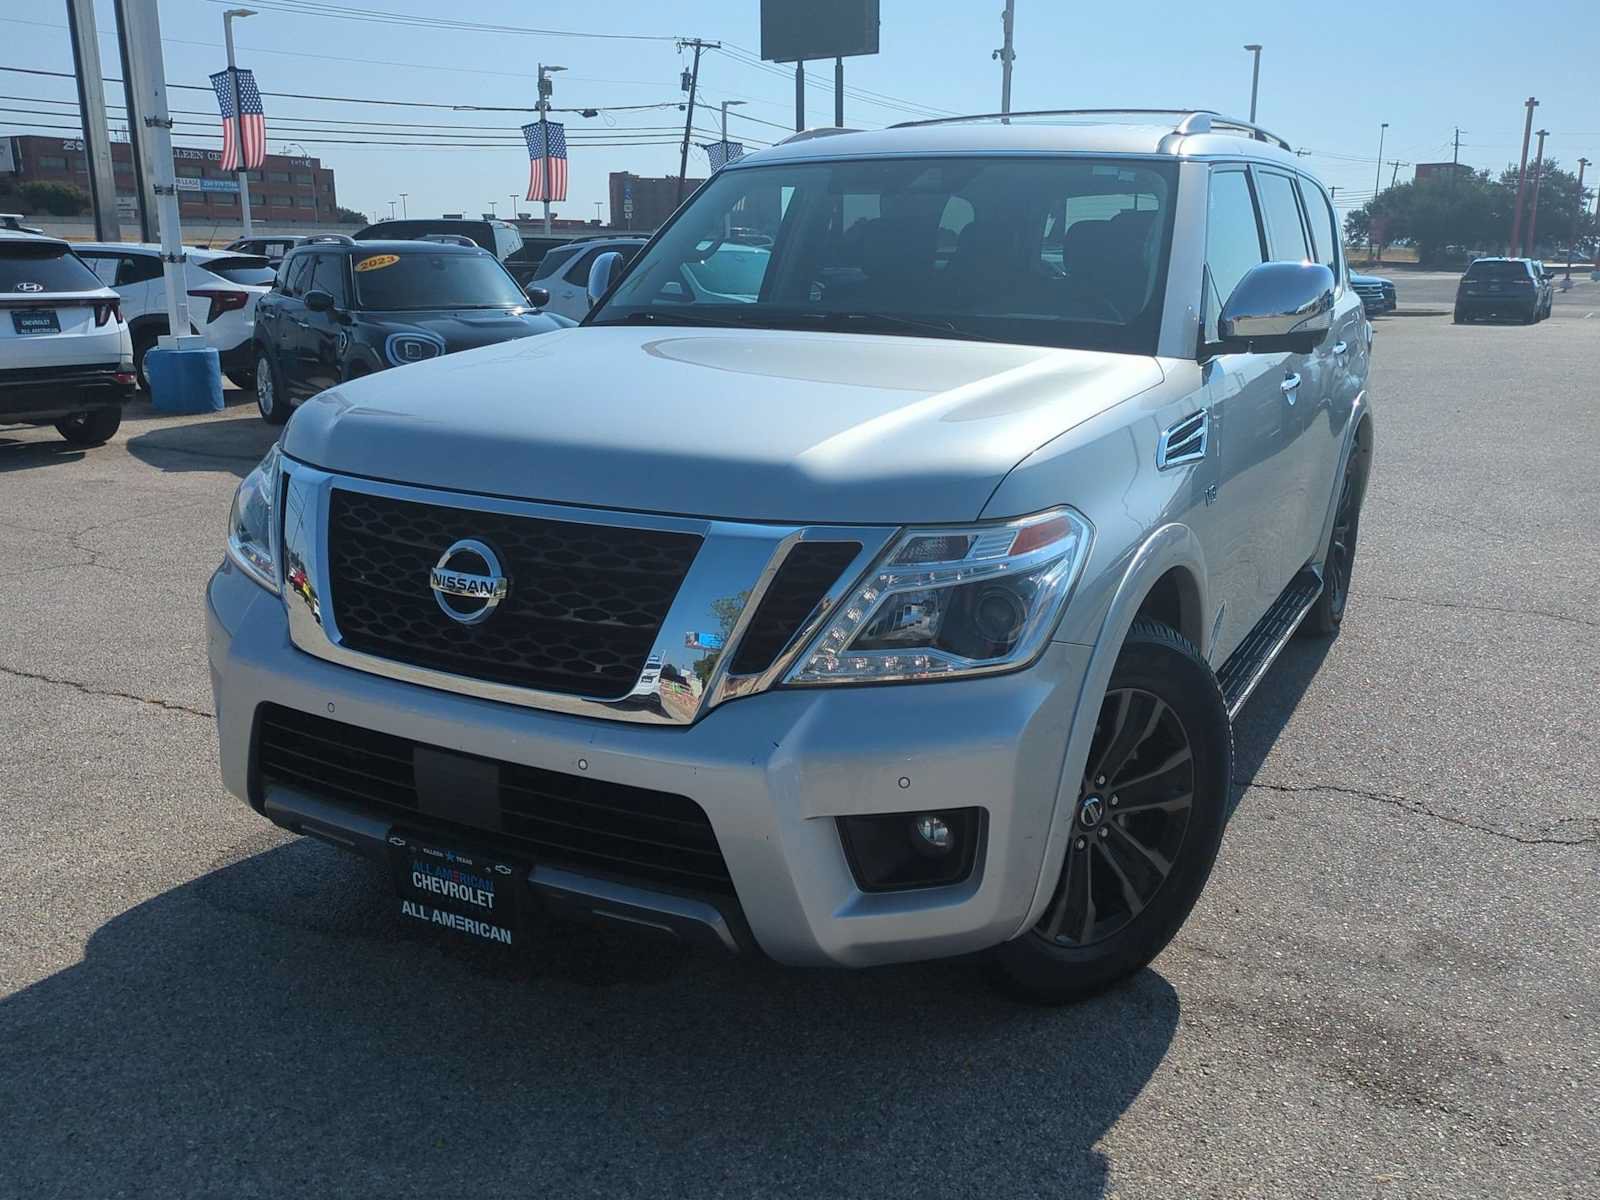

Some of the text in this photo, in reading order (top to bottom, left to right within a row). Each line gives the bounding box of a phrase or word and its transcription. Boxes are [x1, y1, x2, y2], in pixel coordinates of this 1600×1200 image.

[360, 255, 395, 270] 2023
[432, 573, 495, 595] NISSAN
[412, 871, 495, 909] CHEVROLET
[402, 900, 512, 945] ALL AMERICAN
